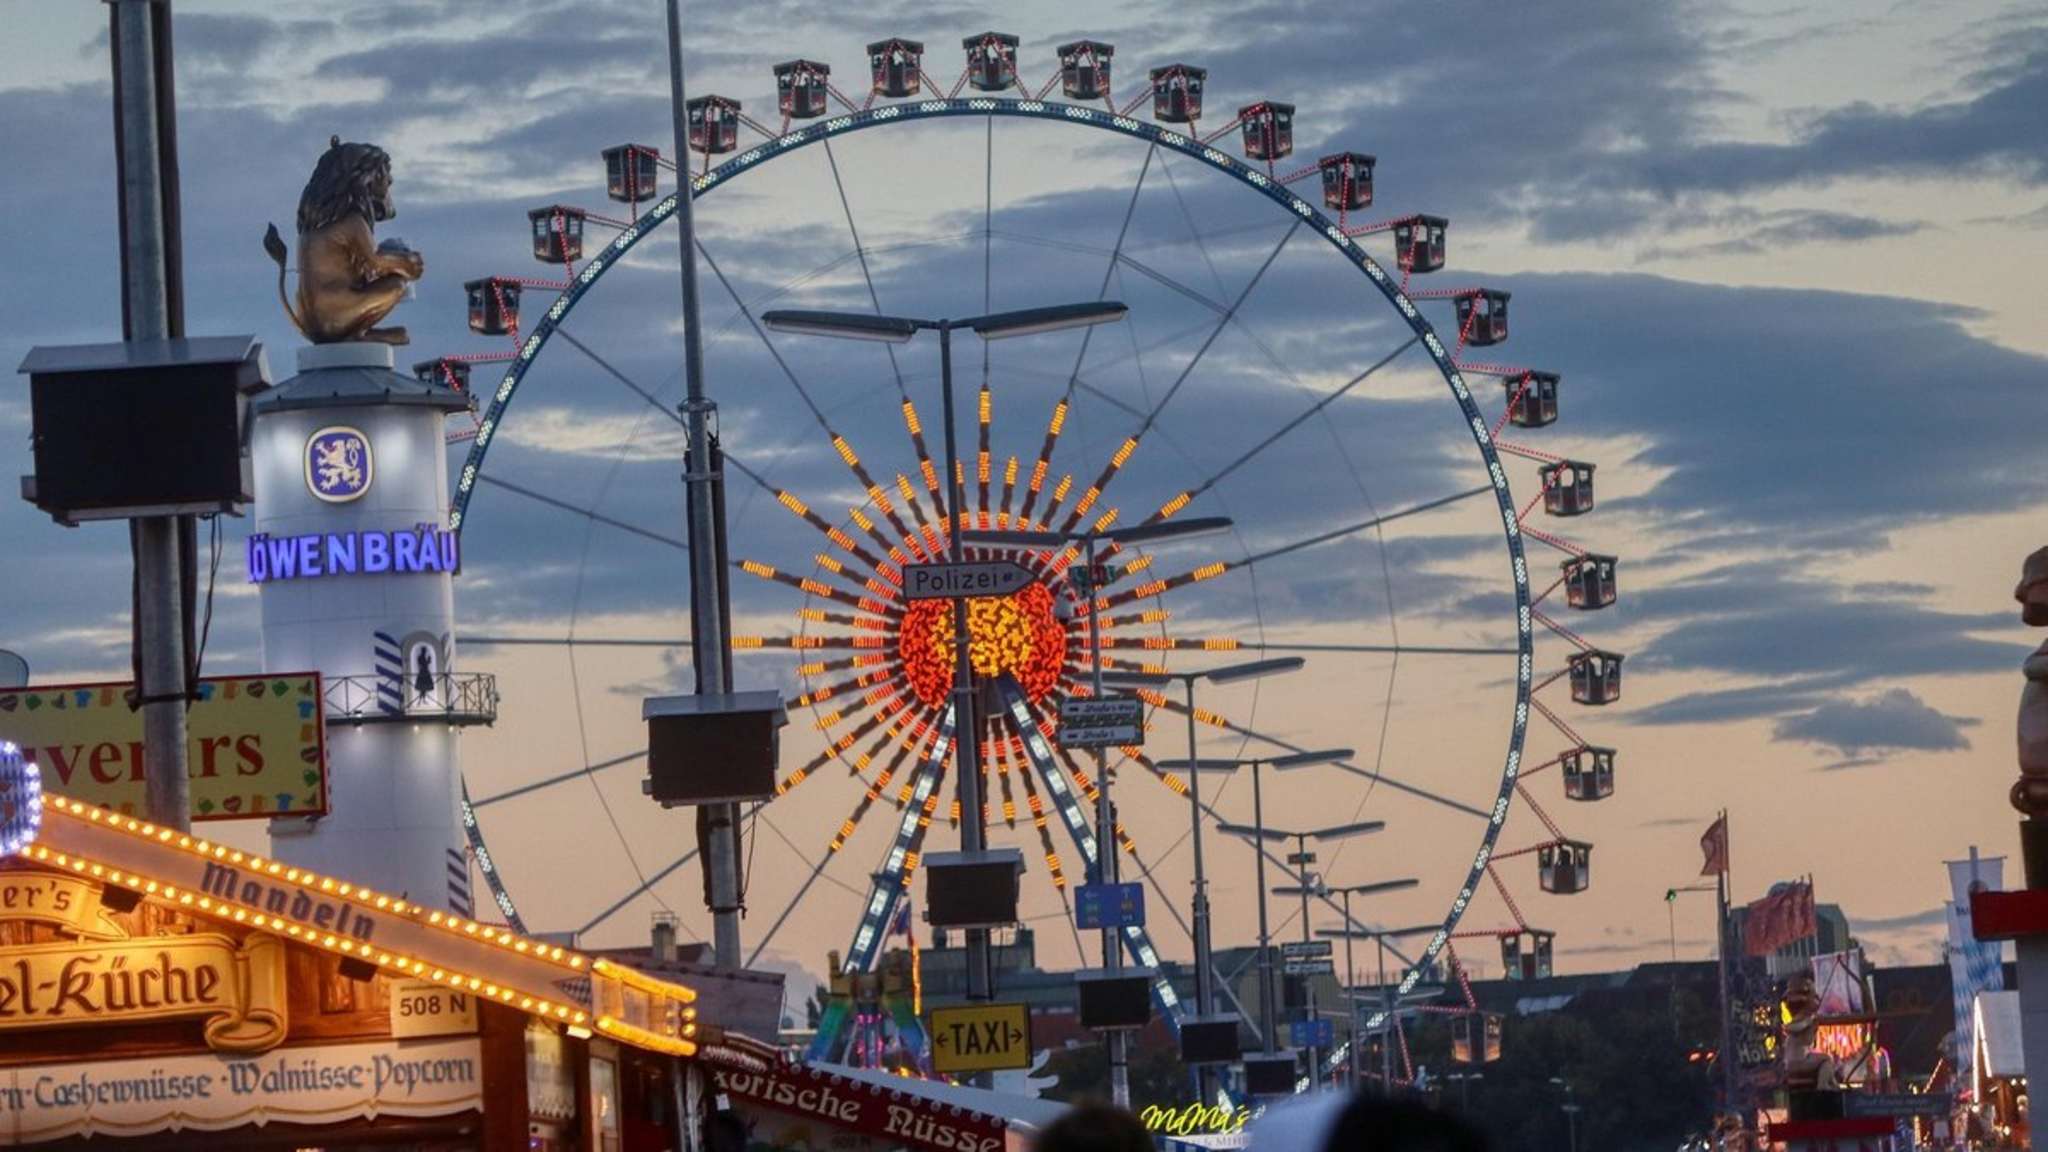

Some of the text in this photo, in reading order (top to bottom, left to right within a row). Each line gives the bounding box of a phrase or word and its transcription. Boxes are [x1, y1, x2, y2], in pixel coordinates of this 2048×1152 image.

[916, 570, 998, 592] Polizei
[201, 860, 375, 941] Mandeln
[400, 993, 467, 1017] 508 N
[949, 1020, 1009, 1056] TAXI
[34, 1069, 212, 1111] Cashewnüsse
[228, 1057, 364, 1095] Walnüsse
[371, 1053, 475, 1097] Popcorn
